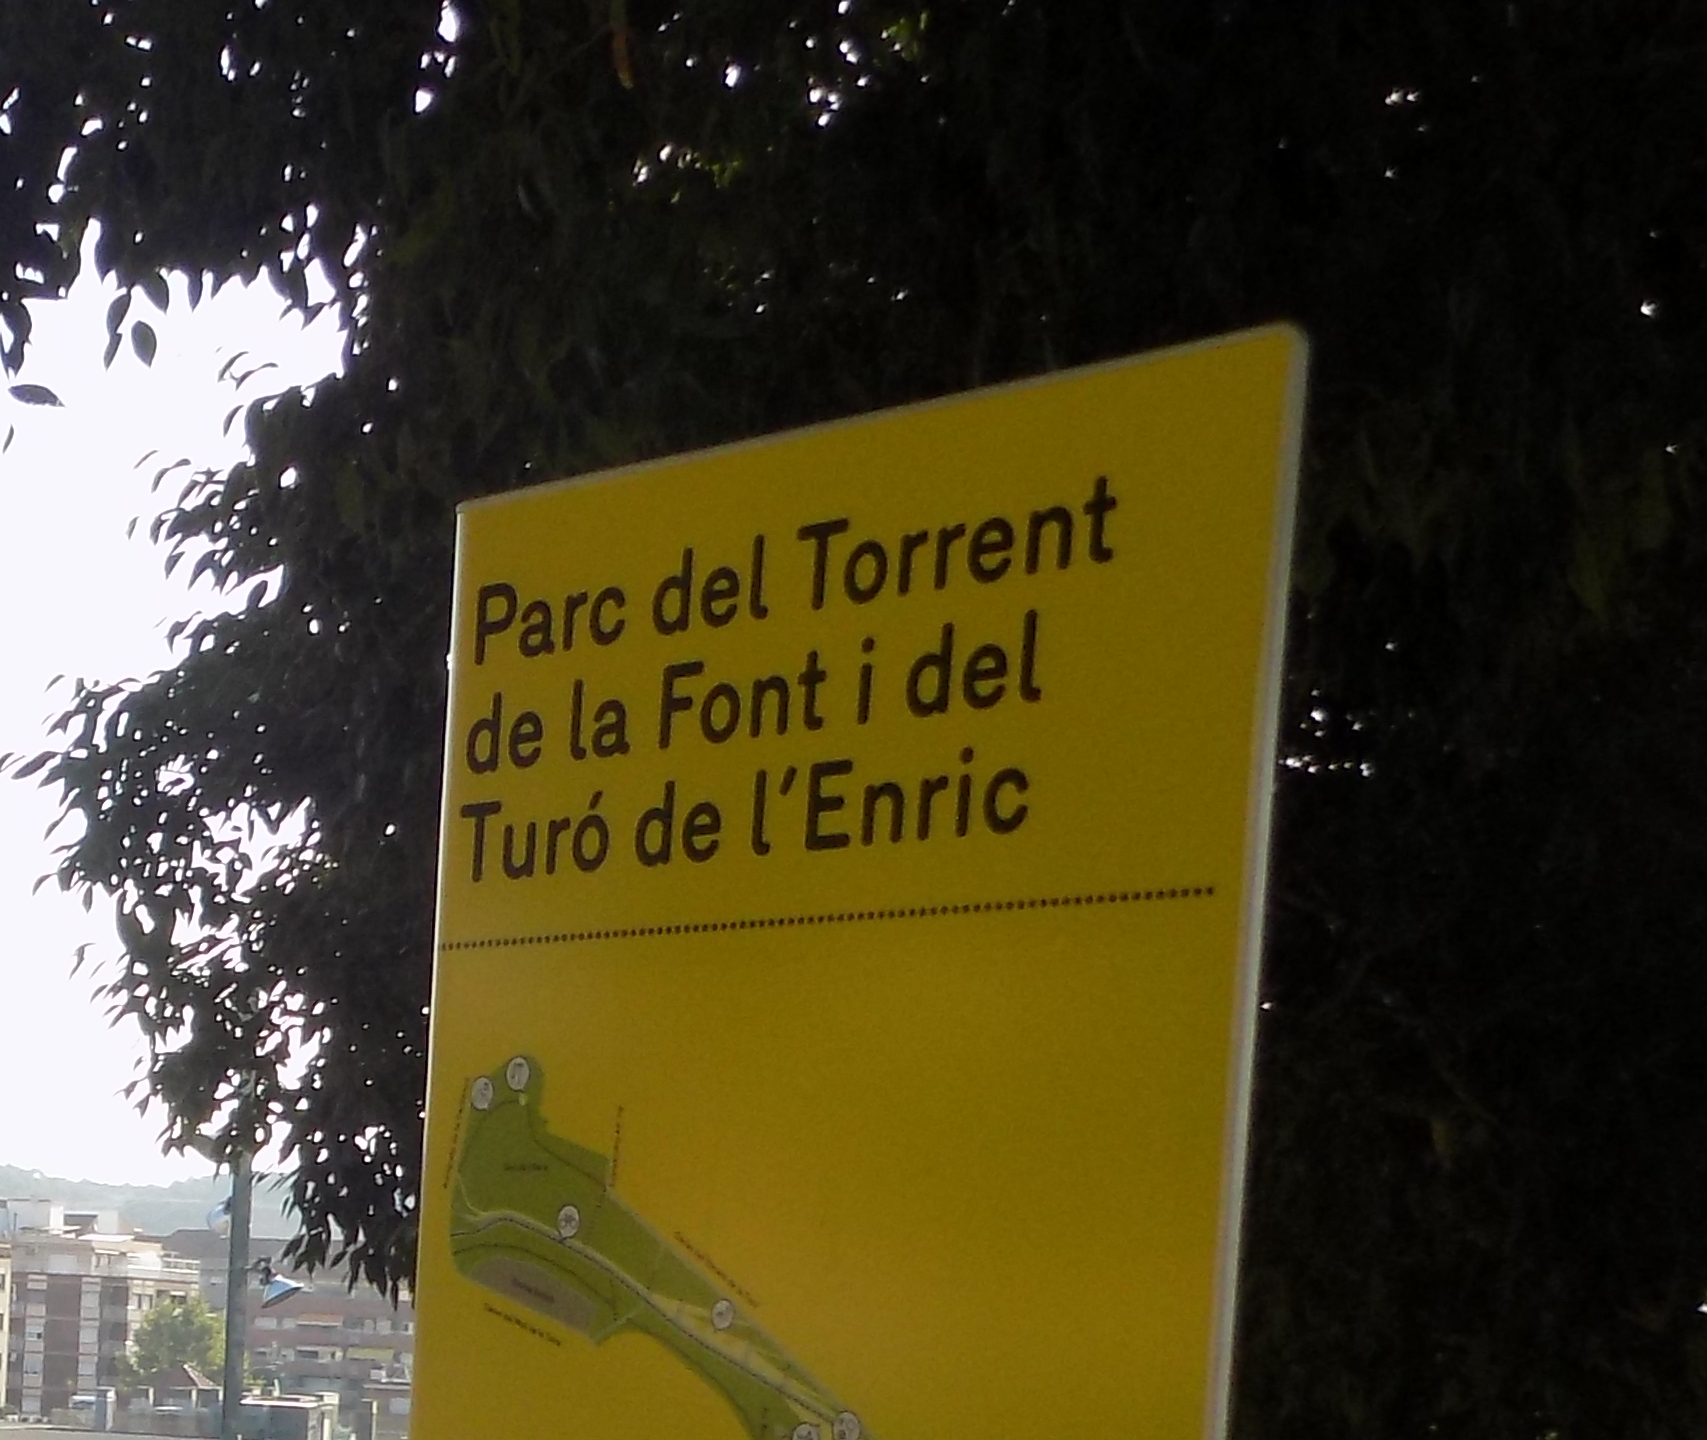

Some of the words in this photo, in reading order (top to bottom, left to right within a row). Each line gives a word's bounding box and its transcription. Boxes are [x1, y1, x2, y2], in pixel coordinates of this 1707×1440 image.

[475, 582, 626, 665] Parc
[652, 534, 769, 636] del
[796, 475, 1119, 611] Torrent
[466, 692, 543, 775] de
[569, 679, 630, 761] la
[658, 648, 828, 750] Font
[857, 636, 876, 725] i
[906, 608, 1042, 718] del
[460, 790, 610, 882] Turó
[635, 780, 723, 867] de
[751, 746, 1031, 856] l'Enric
